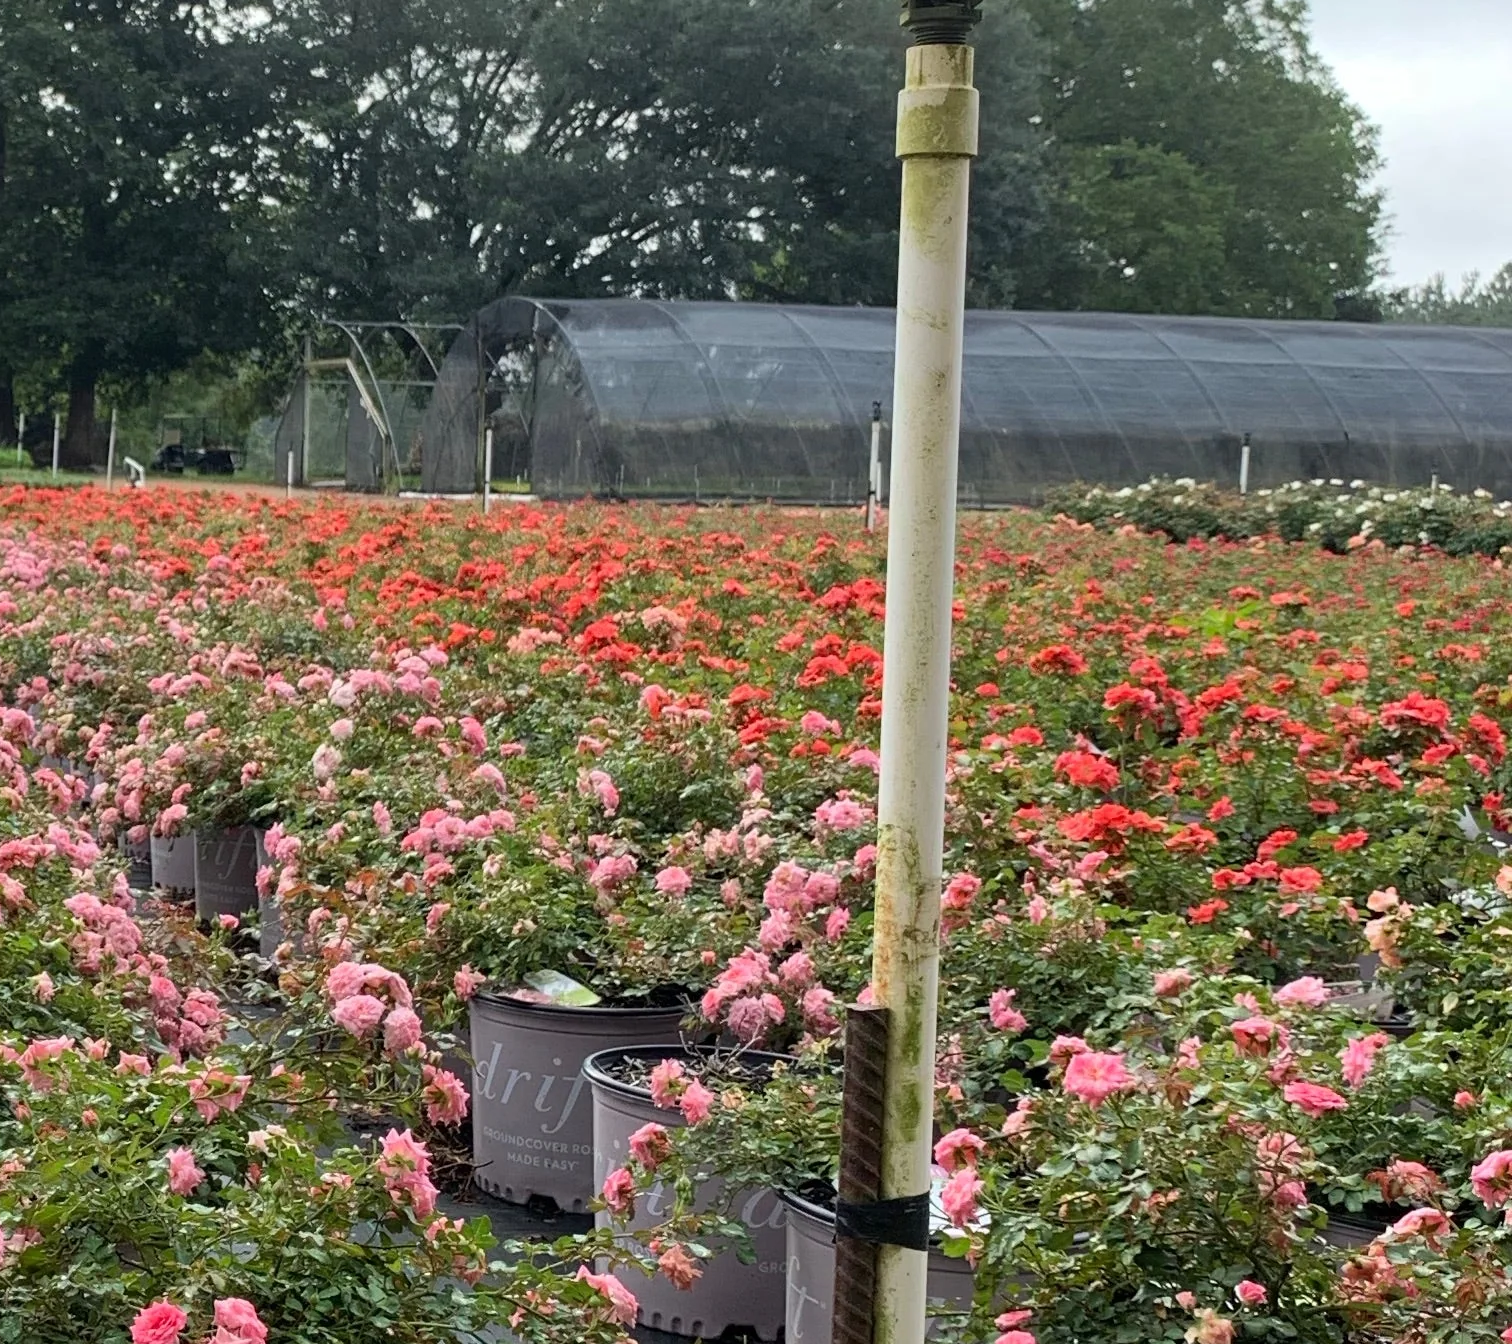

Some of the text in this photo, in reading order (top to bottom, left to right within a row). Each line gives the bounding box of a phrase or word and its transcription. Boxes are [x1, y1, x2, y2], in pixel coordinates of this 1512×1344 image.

[475, 1040, 589, 1134] drif
[483, 1125, 568, 1154] GROUNDCOVER
[507, 1151, 541, 1167] MADE
